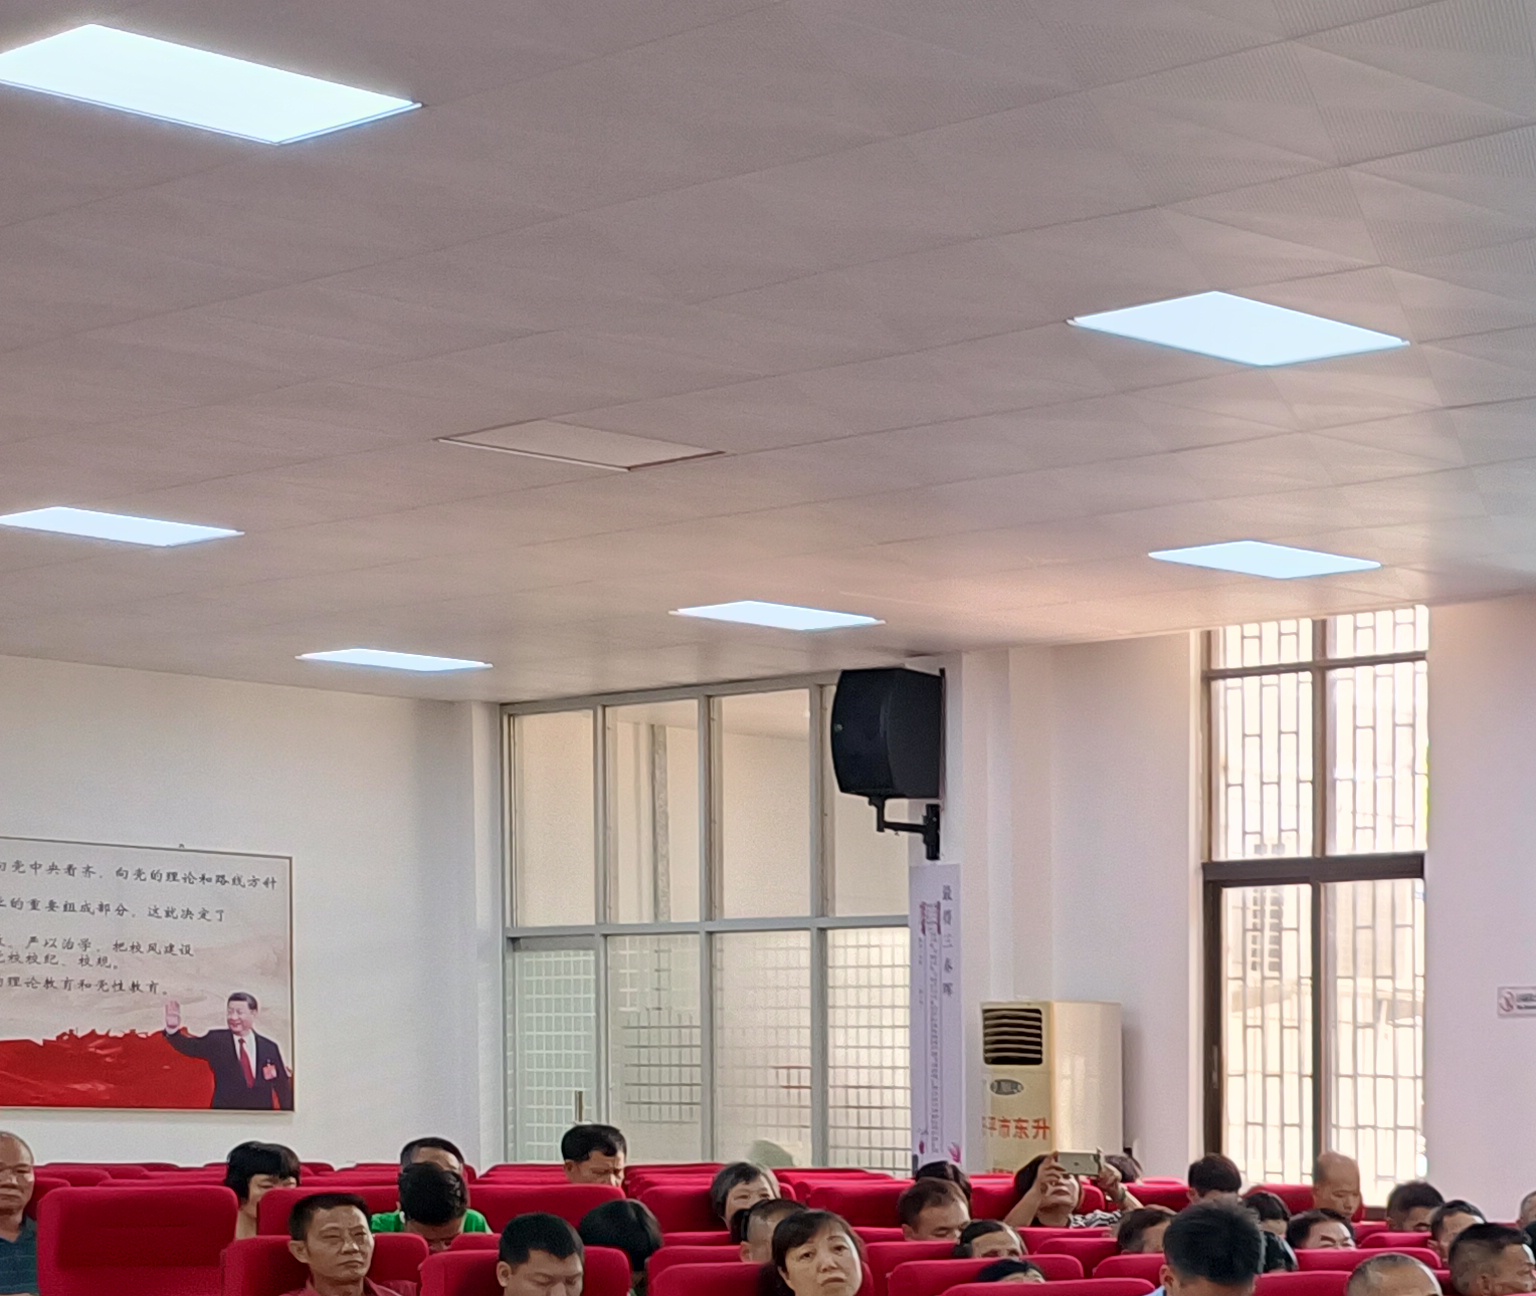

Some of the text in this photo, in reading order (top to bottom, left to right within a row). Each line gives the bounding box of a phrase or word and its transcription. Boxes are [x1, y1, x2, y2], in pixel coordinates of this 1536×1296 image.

[0, 976, 168, 996] 理论教育和党性教育。
